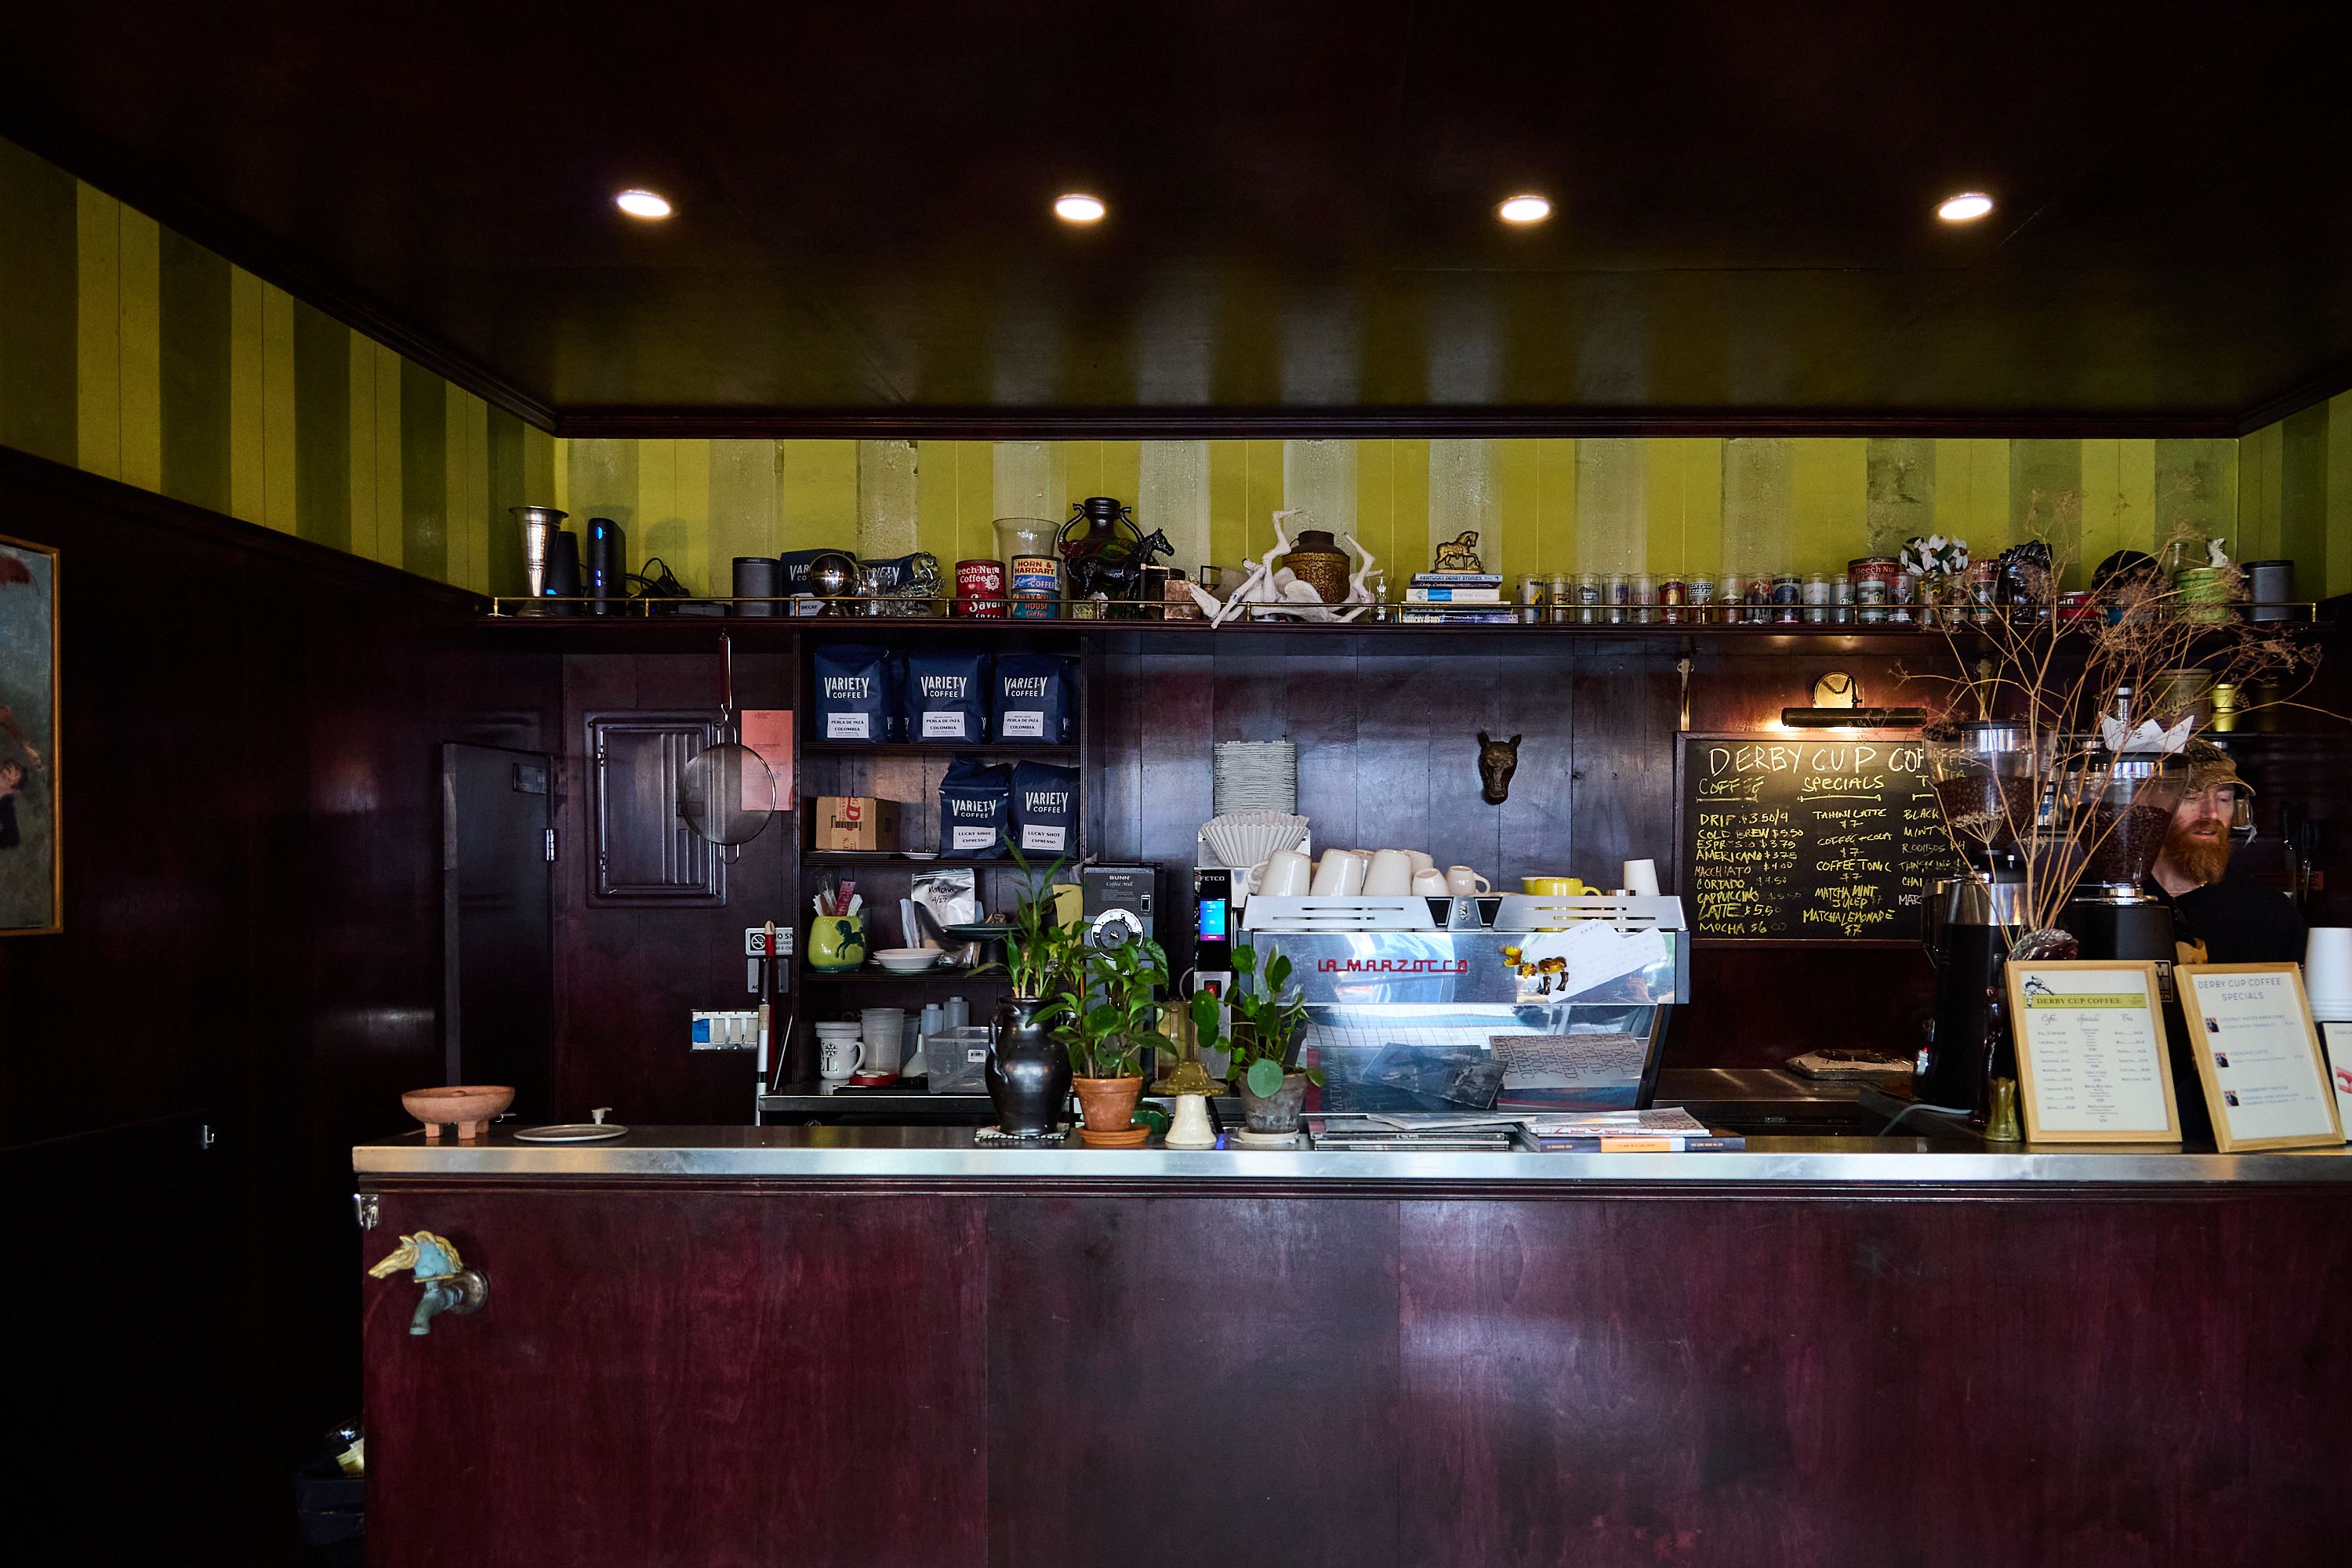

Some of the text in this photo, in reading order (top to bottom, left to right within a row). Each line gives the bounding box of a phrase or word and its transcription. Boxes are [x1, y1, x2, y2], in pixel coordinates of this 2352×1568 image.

[960, 575, 986, 583] Coffee
[1030, 580, 1054, 589] COFFEE
[824, 677, 869, 699] VARIETY
[920, 677, 967, 698] VARIETY
[1004, 677, 1048, 697] VARIETY
[1708, 744, 1803, 777] DERBY
[1811, 746, 1877, 774] CUP
[1699, 775, 1766, 795] COFFEE
[1802, 775, 1885, 793] SPECIALS
[951, 799, 996, 817] VARIETY
[1025, 791, 1069, 813] VARIETY
[1700, 813, 1736, 828] DRIP
[1812, 808, 1887, 820] TAHINI LATTE
[1903, 809, 1940, 820] BLACK
[1840, 820, 1864, 829] $7
[1697, 829, 1731, 840] COLD
[1736, 828, 1769, 839] BREW
[1904, 826, 1936, 837] MINT
[1817, 833, 1857, 847] COFFEE
[1839, 847, 1864, 858] $7
[1902, 843, 1947, 856] ROOIBOS
[1695, 849, 1762, 864] AMERICANO
[1694, 865, 1751, 878] MACCHIATO
[1816, 858, 1893, 873] COFFEE TONIC
[1697, 878, 1745, 891] CORTADO
[1839, 873, 1863, 883] $7
[1901, 877, 1923, 887] CHAI
[927, 885, 957, 895] Matcha
[1697, 886, 1760, 904] CAPPUCCINO
[1815, 884, 1880, 900] MATCHA MINT
[1831, 898, 1868, 911] JULEP
[1802, 908, 1842, 924] MATCHA
[1699, 922, 1745, 935] MOCHA
[1843, 924, 1863, 937] $7
[1318, 959, 1337, 972] LA
[2198, 977, 2282, 989] DERBY CUP COFFEE
[2221, 991, 2265, 1002] SPECIALS
